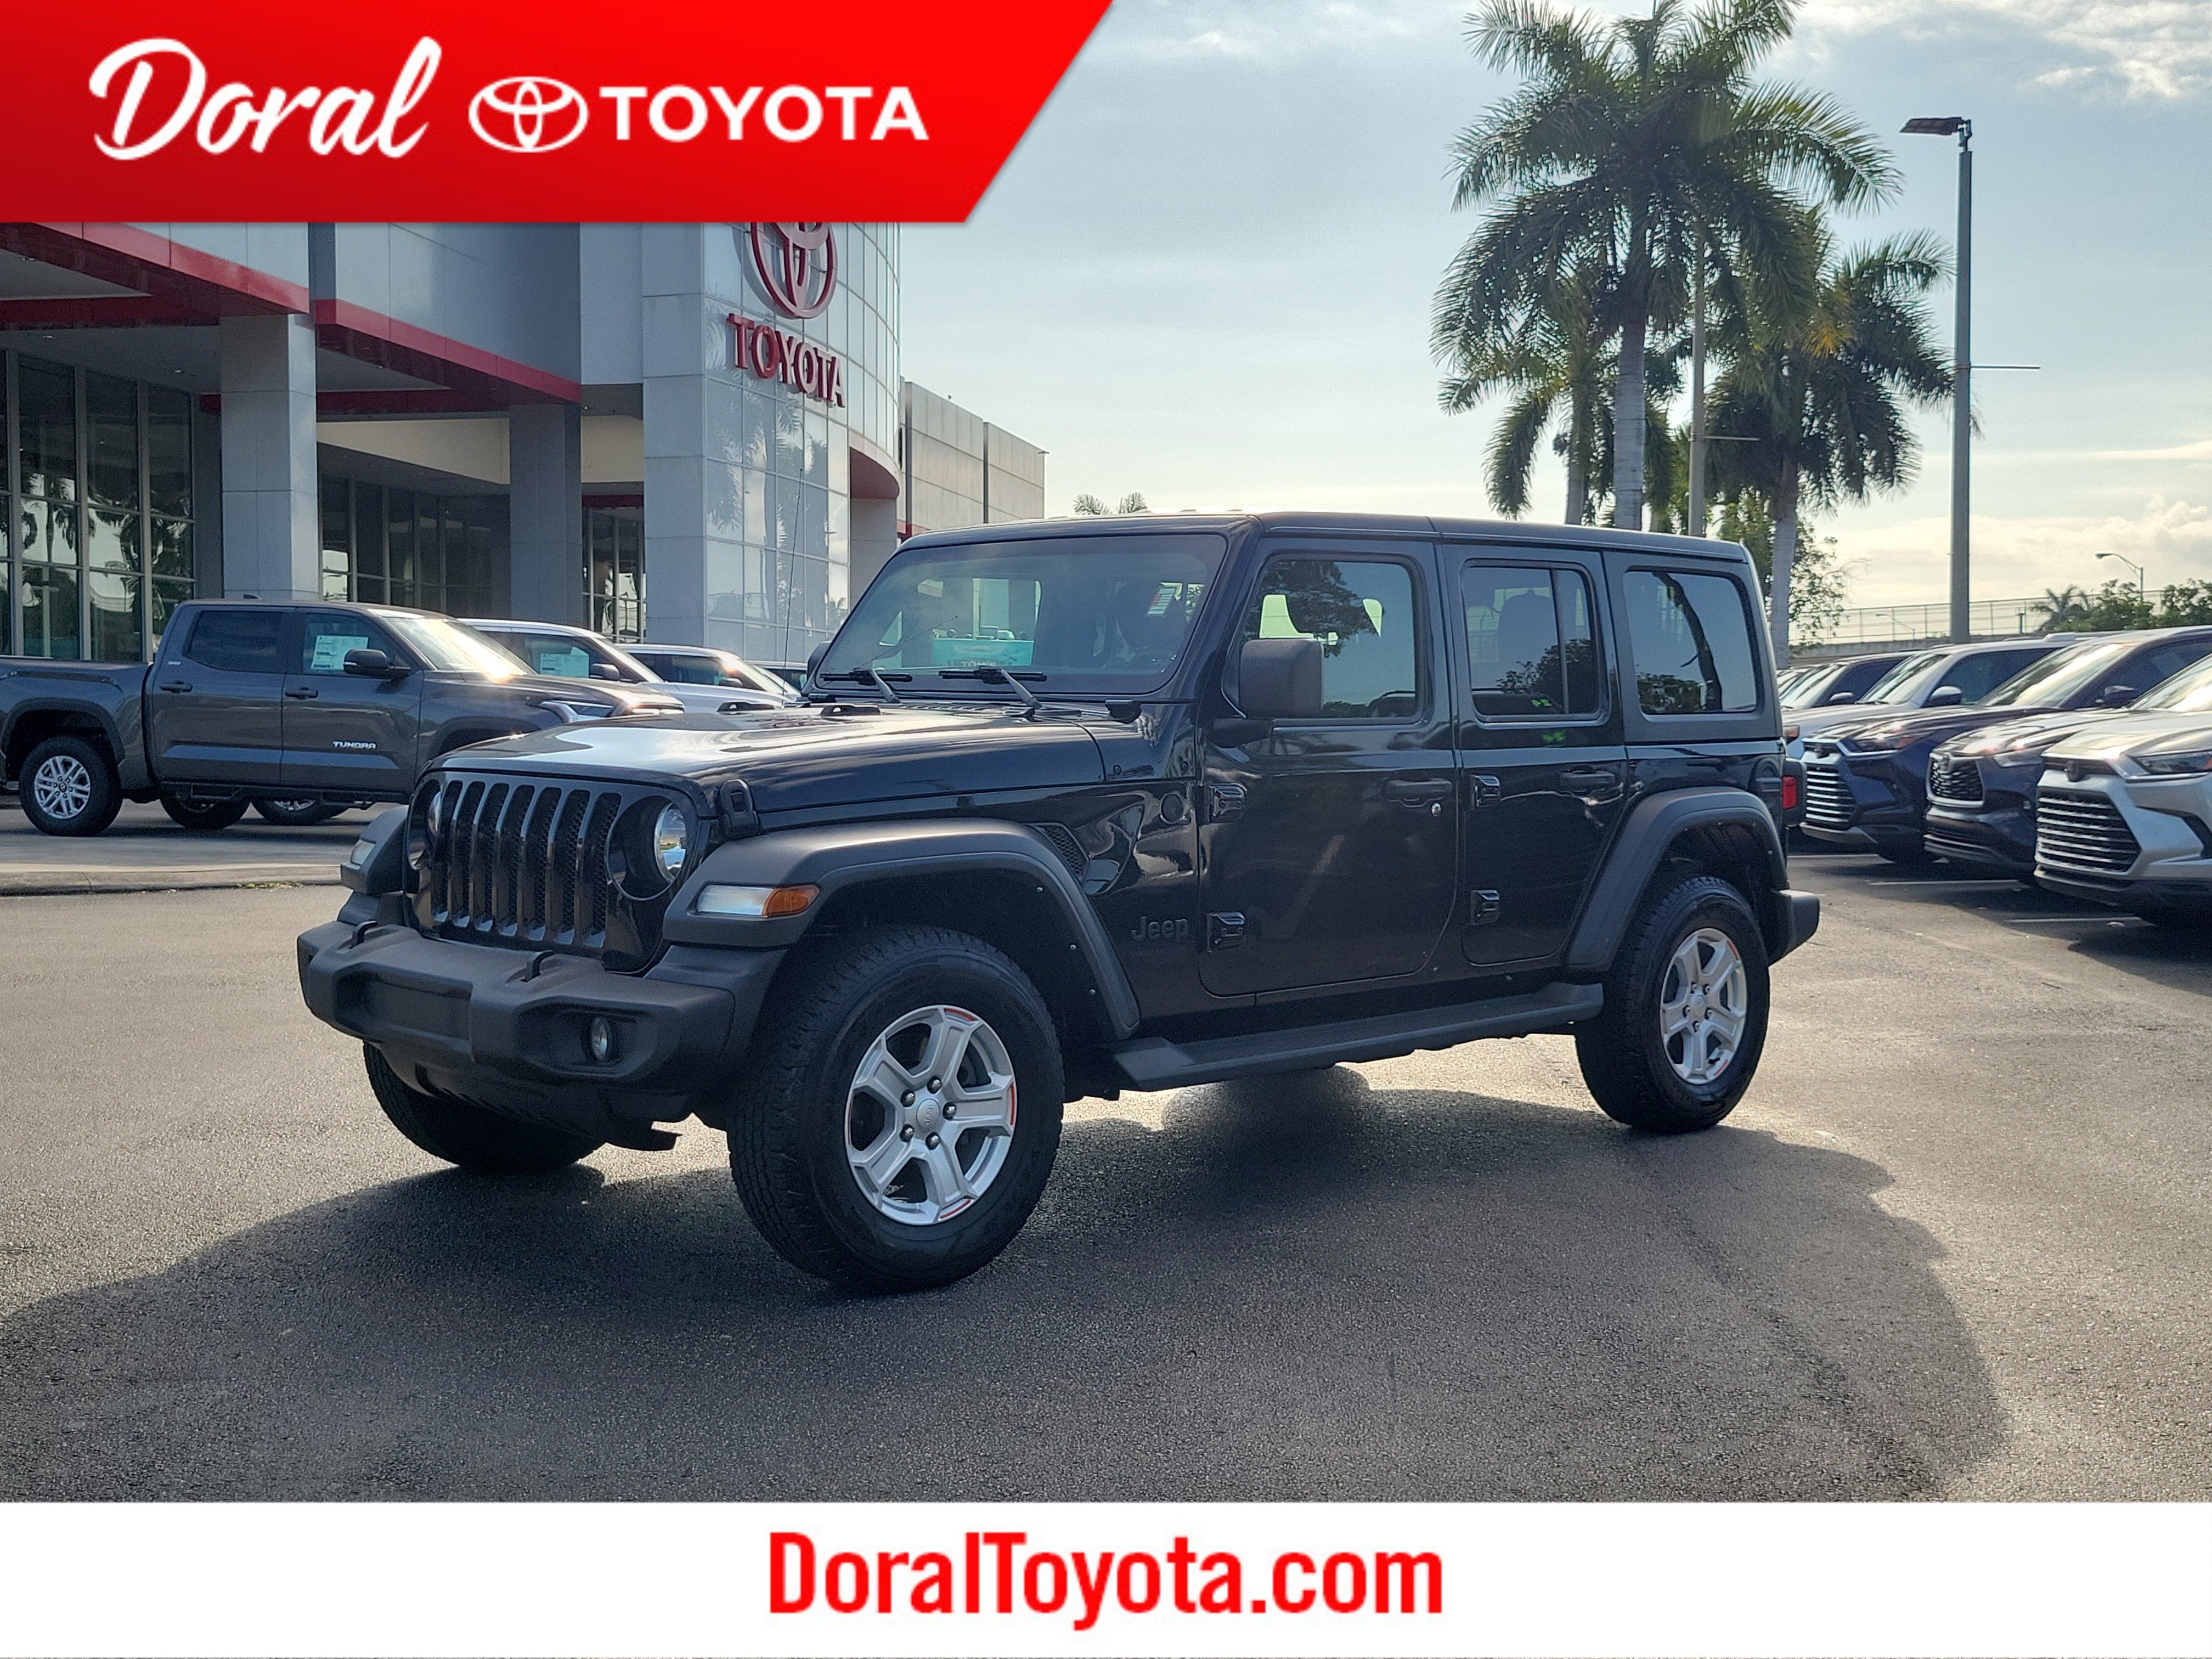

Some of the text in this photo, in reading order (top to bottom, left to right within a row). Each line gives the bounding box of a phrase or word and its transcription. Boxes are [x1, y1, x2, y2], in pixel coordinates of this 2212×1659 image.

[727, 313, 845, 408] TOYOTA
[332, 741, 376, 749] TUNDRA
[1130, 916, 1190, 944] Jeep
